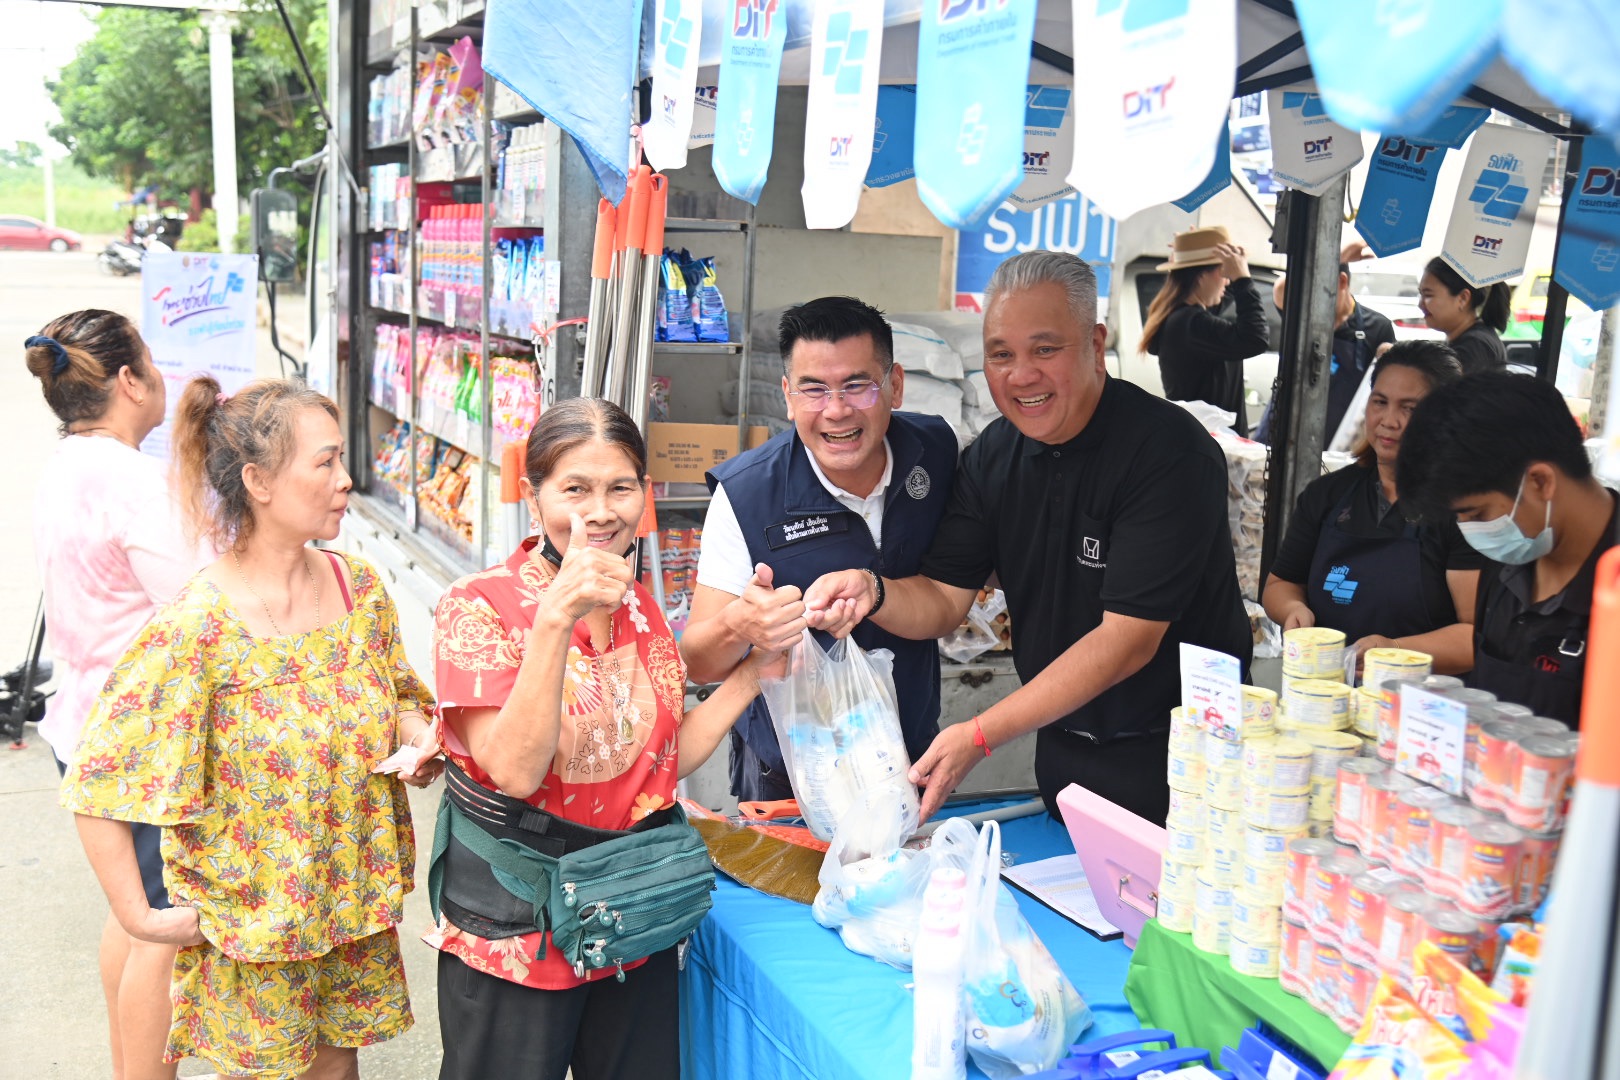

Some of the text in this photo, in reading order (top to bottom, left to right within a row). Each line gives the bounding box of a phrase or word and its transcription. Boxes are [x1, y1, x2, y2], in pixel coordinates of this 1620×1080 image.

[1123, 75, 1177, 118] DiT
[1304, 136, 1333, 155] DiT
[1381, 136, 1438, 163] DiT
[1581, 167, 1620, 199] Di
[984, 193, 1110, 258] ธงฟา
[1473, 234, 1503, 251] DiT
